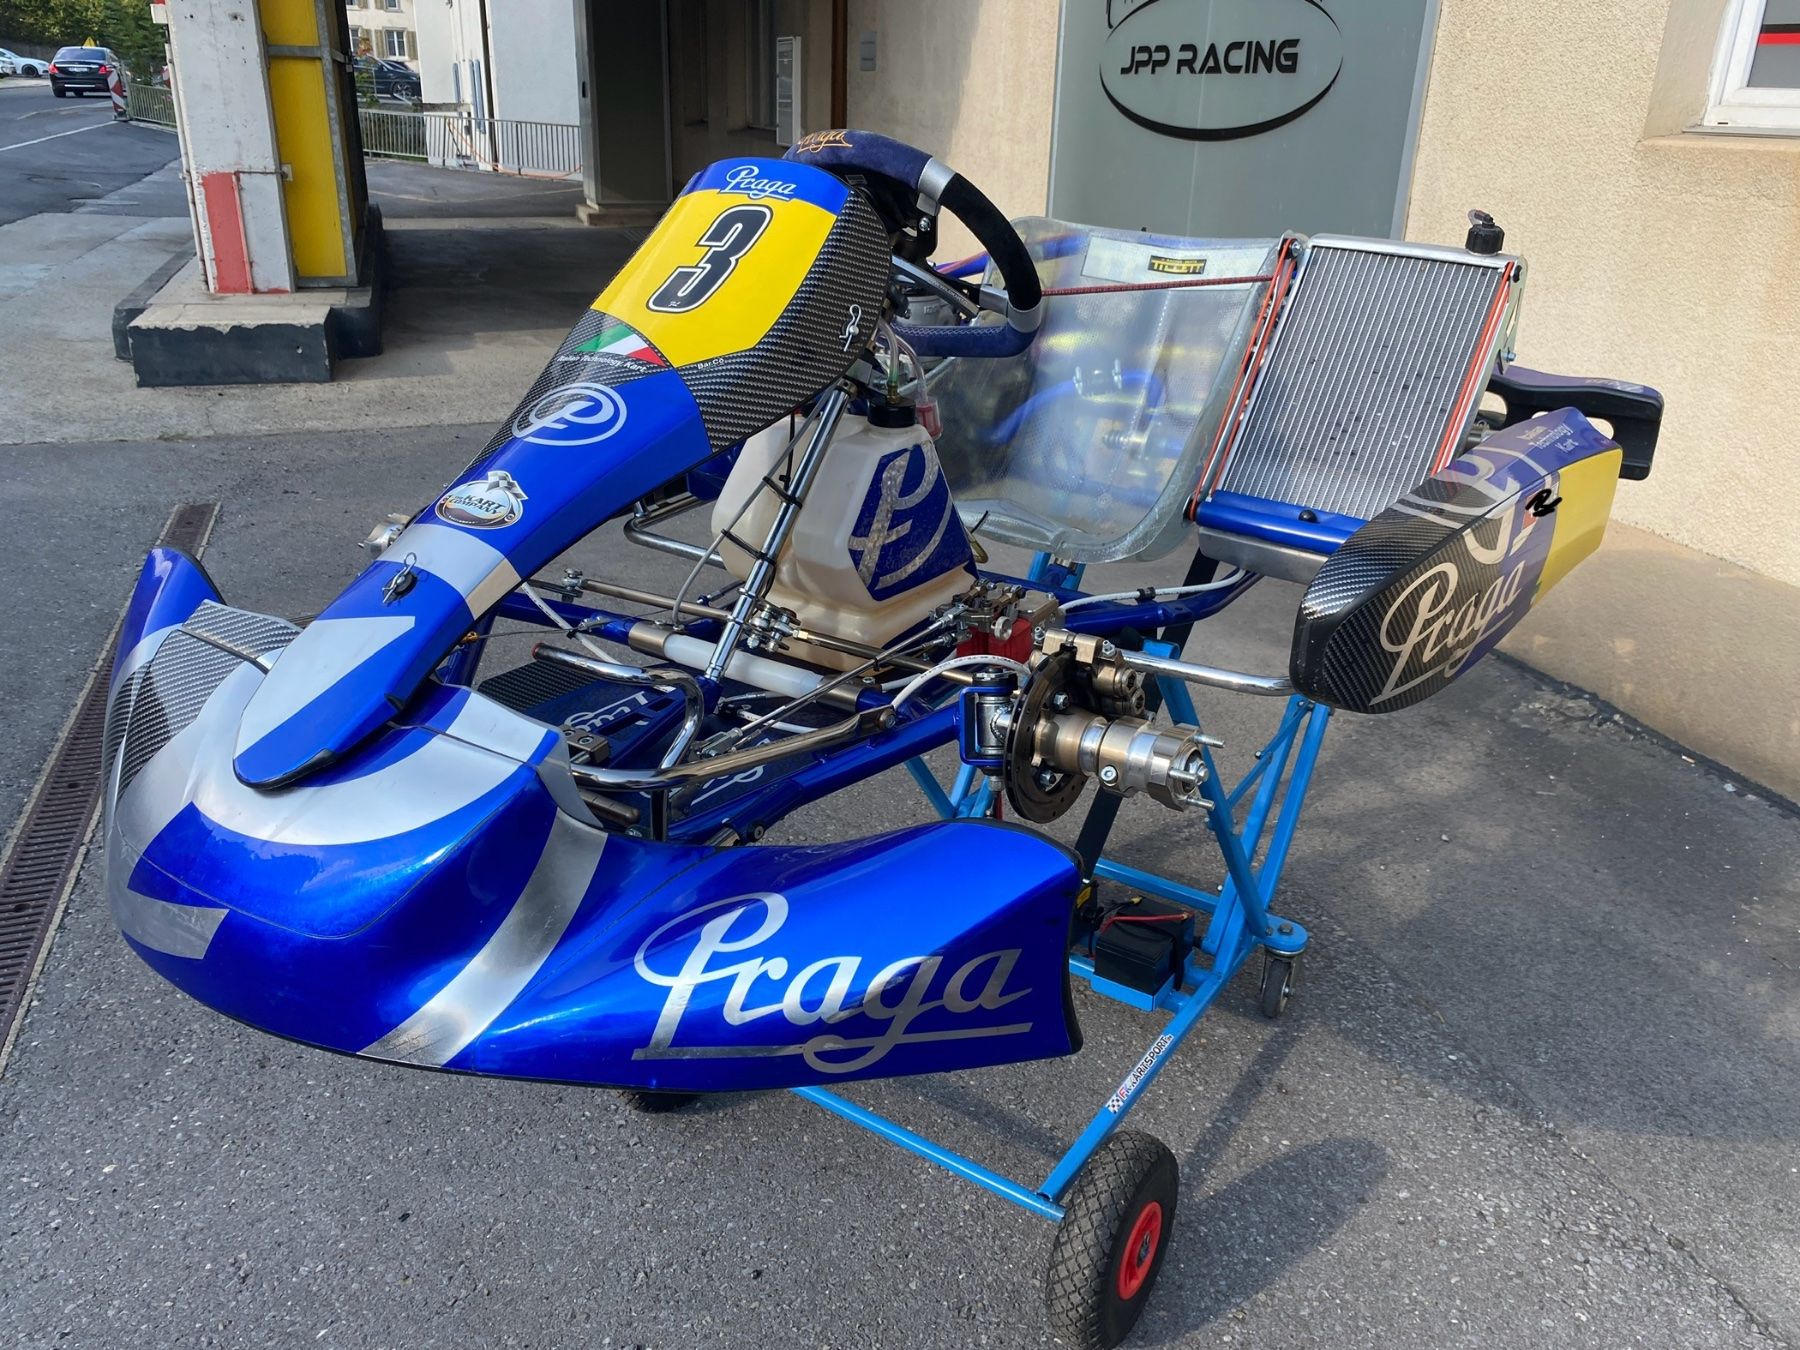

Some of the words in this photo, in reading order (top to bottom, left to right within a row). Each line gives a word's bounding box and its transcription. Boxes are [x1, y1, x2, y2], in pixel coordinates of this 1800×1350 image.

[1120, 45, 1170, 75] JPP
[1176, 39, 1300, 75] RACING
[719, 165, 797, 200] Praga
[646, 204, 774, 314] 3
[624, 361, 647, 372] Kart
[463, 494, 506, 509] KART
[1369, 560, 1526, 706] Praga
[631, 892, 1033, 1074] Praga
